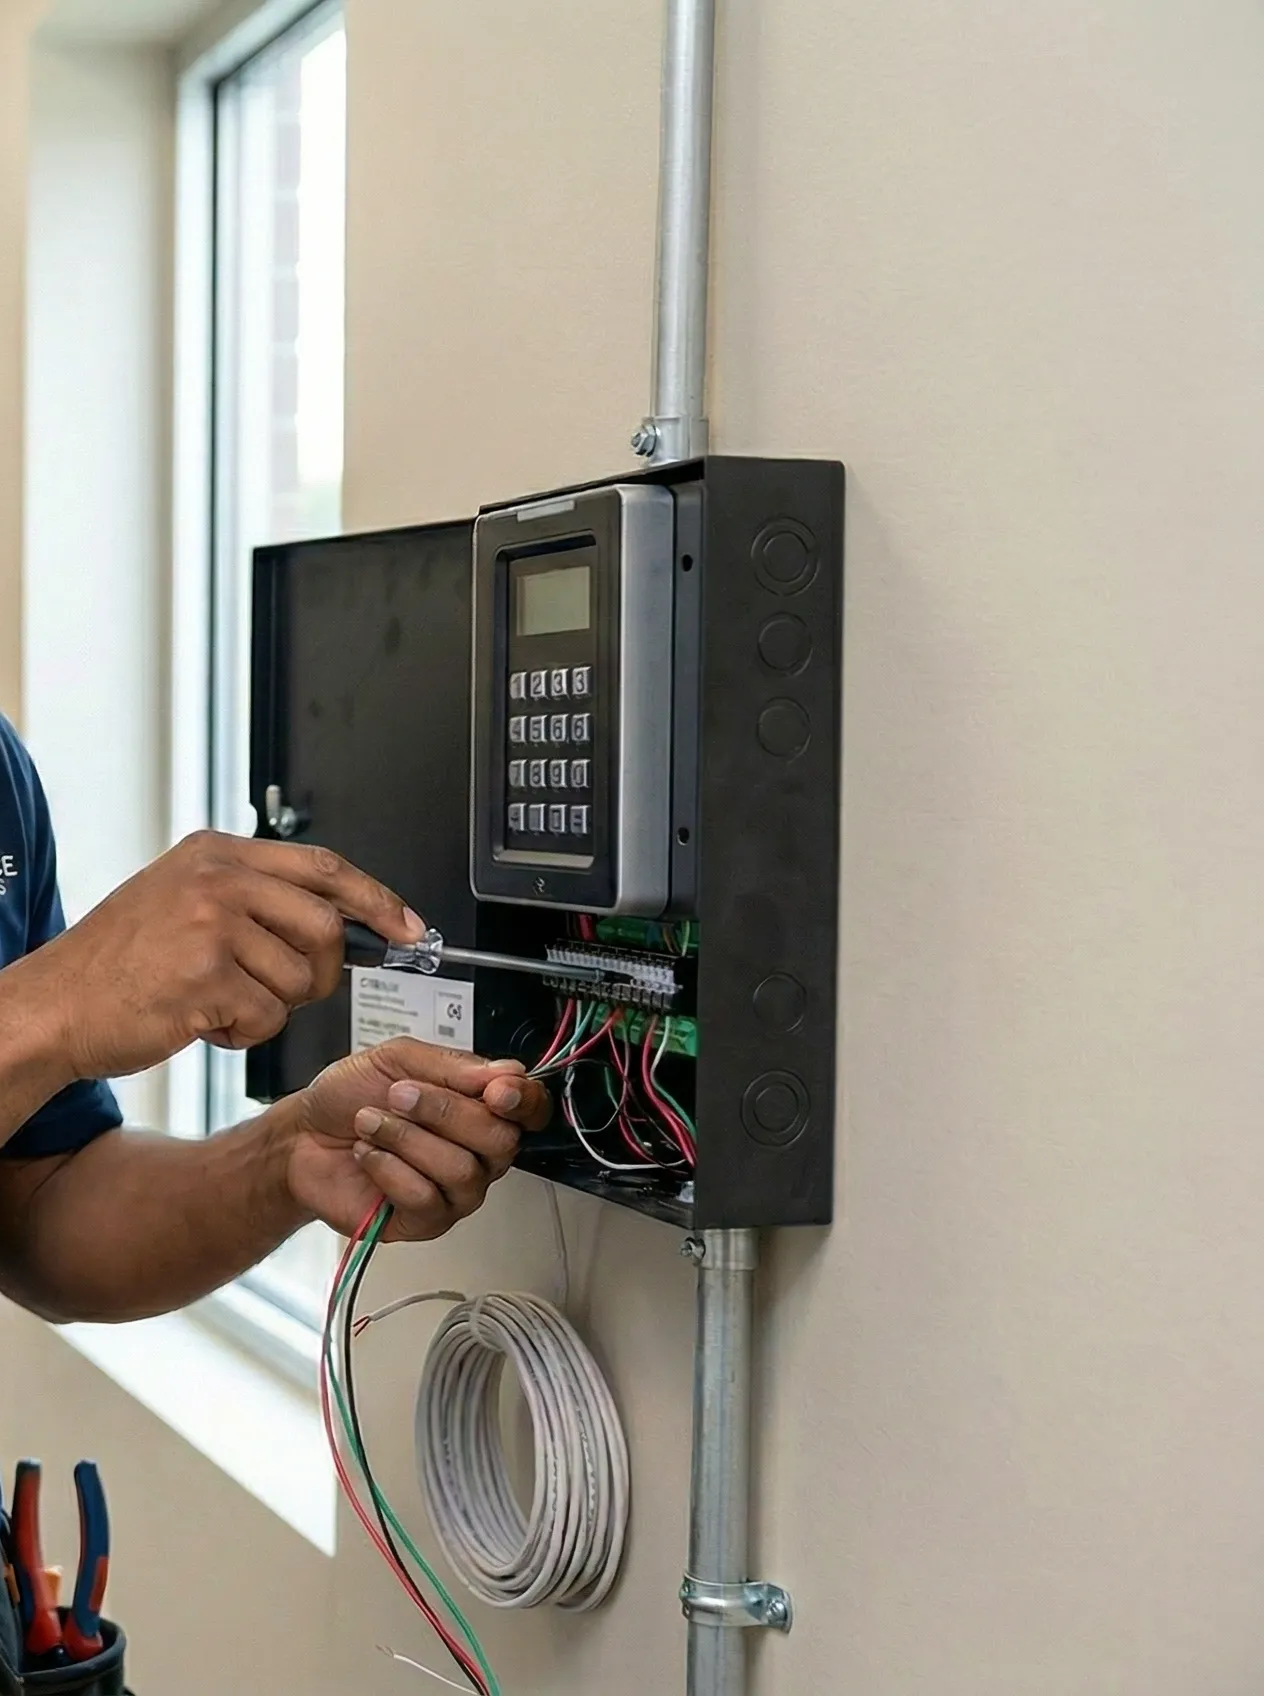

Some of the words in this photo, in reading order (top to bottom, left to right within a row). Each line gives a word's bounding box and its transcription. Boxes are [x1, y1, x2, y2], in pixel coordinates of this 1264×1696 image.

[532, 673, 542, 695] 2
[553, 672, 563, 694] 3
[575, 671, 585, 693] 3
[532, 720, 542, 740] 5
[553, 720, 563, 740] 6
[574, 718, 584, 739] 6
[531, 763, 541, 785] 8
[552, 763, 562, 785] 9
